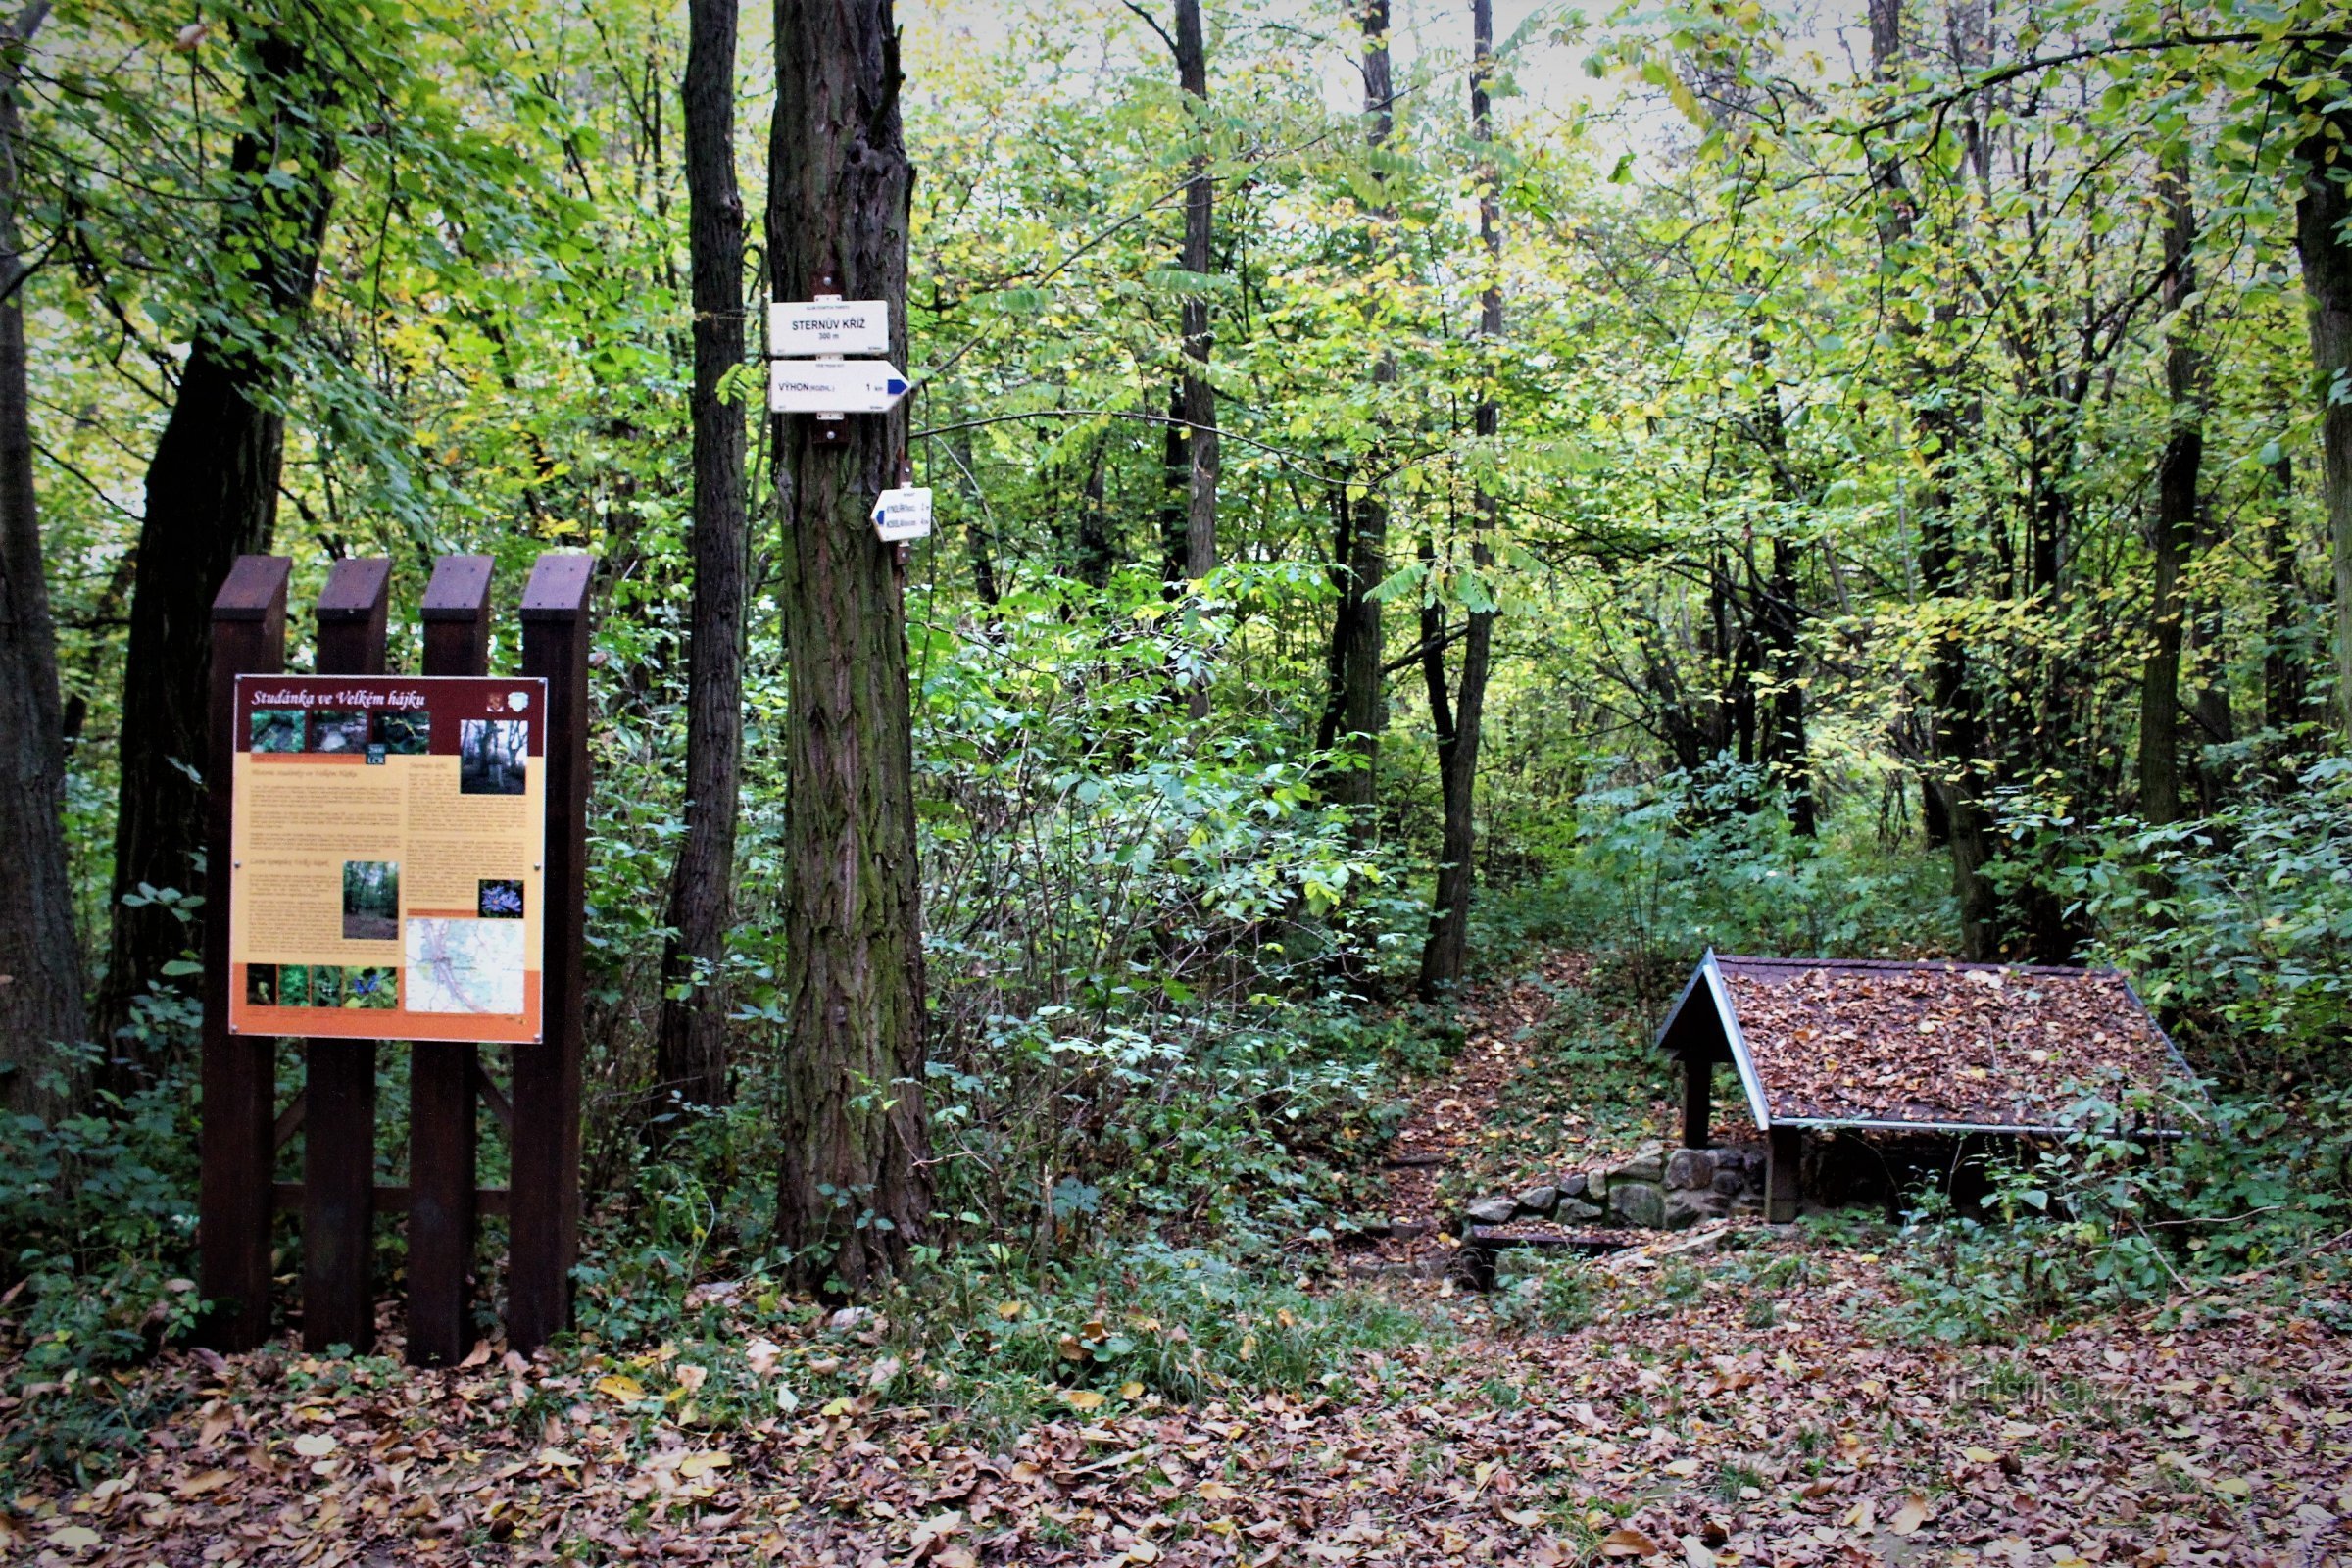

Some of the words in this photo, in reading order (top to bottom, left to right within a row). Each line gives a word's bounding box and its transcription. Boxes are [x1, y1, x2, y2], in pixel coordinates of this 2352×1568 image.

[792, 318, 840, 331] STERNŮV
[843, 316, 866, 329] KŘÍŽ
[778, 380, 809, 391] VÝHON
[251, 689, 315, 708] Studánka
[317, 693, 334, 706] ve
[335, 689, 385, 709] Velkém
[388, 690, 425, 710] hájku
